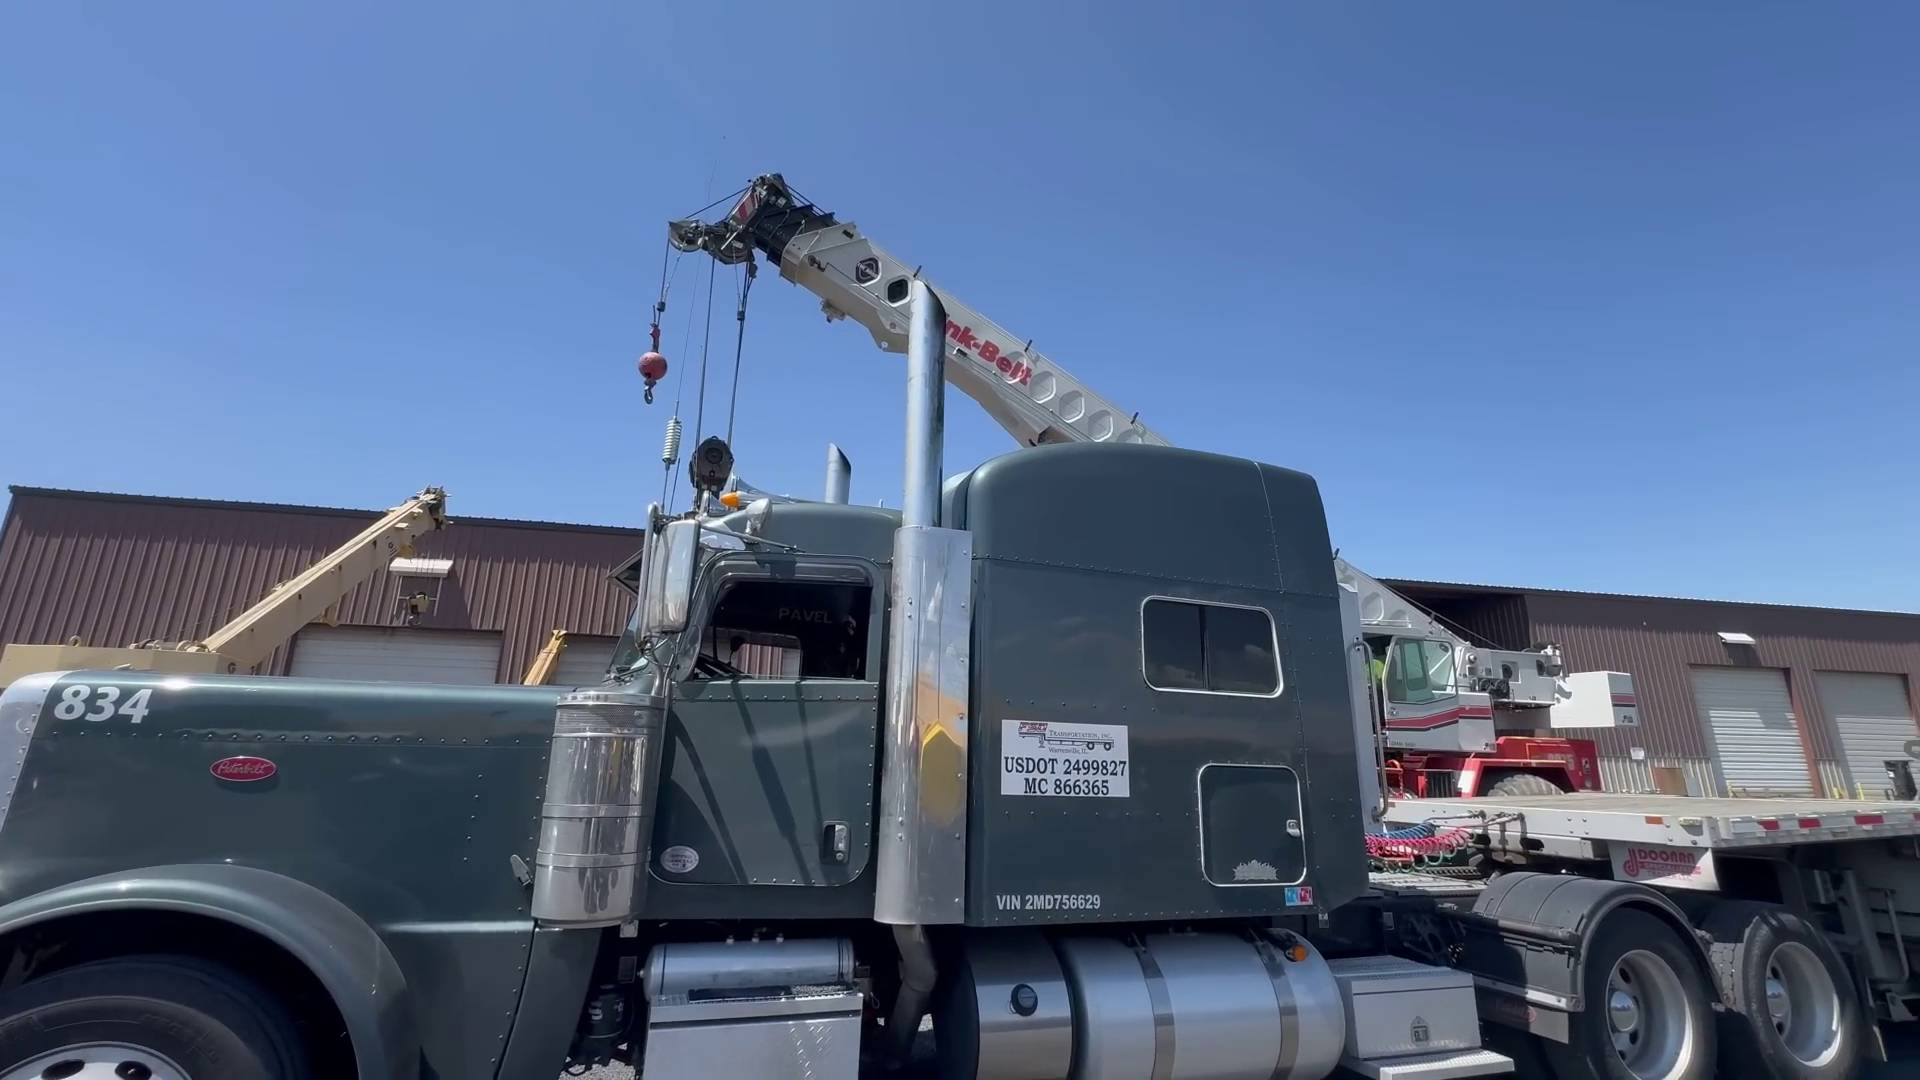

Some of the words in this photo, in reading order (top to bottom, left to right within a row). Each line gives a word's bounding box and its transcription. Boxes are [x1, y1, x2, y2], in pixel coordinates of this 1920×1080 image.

[946, 319, 1032, 386] nk-Belt
[778, 607, 833, 624] PAVEL
[54, 684, 153, 724] 834
[1004, 756, 1059, 774] USDOT
[1063, 758, 1127, 777] 2499827
[1024, 778, 1049, 795] MC
[1054, 778, 1110, 796] 866365
[996, 894, 1021, 910] VIN
[1025, 894, 1101, 910] 2MD756629
